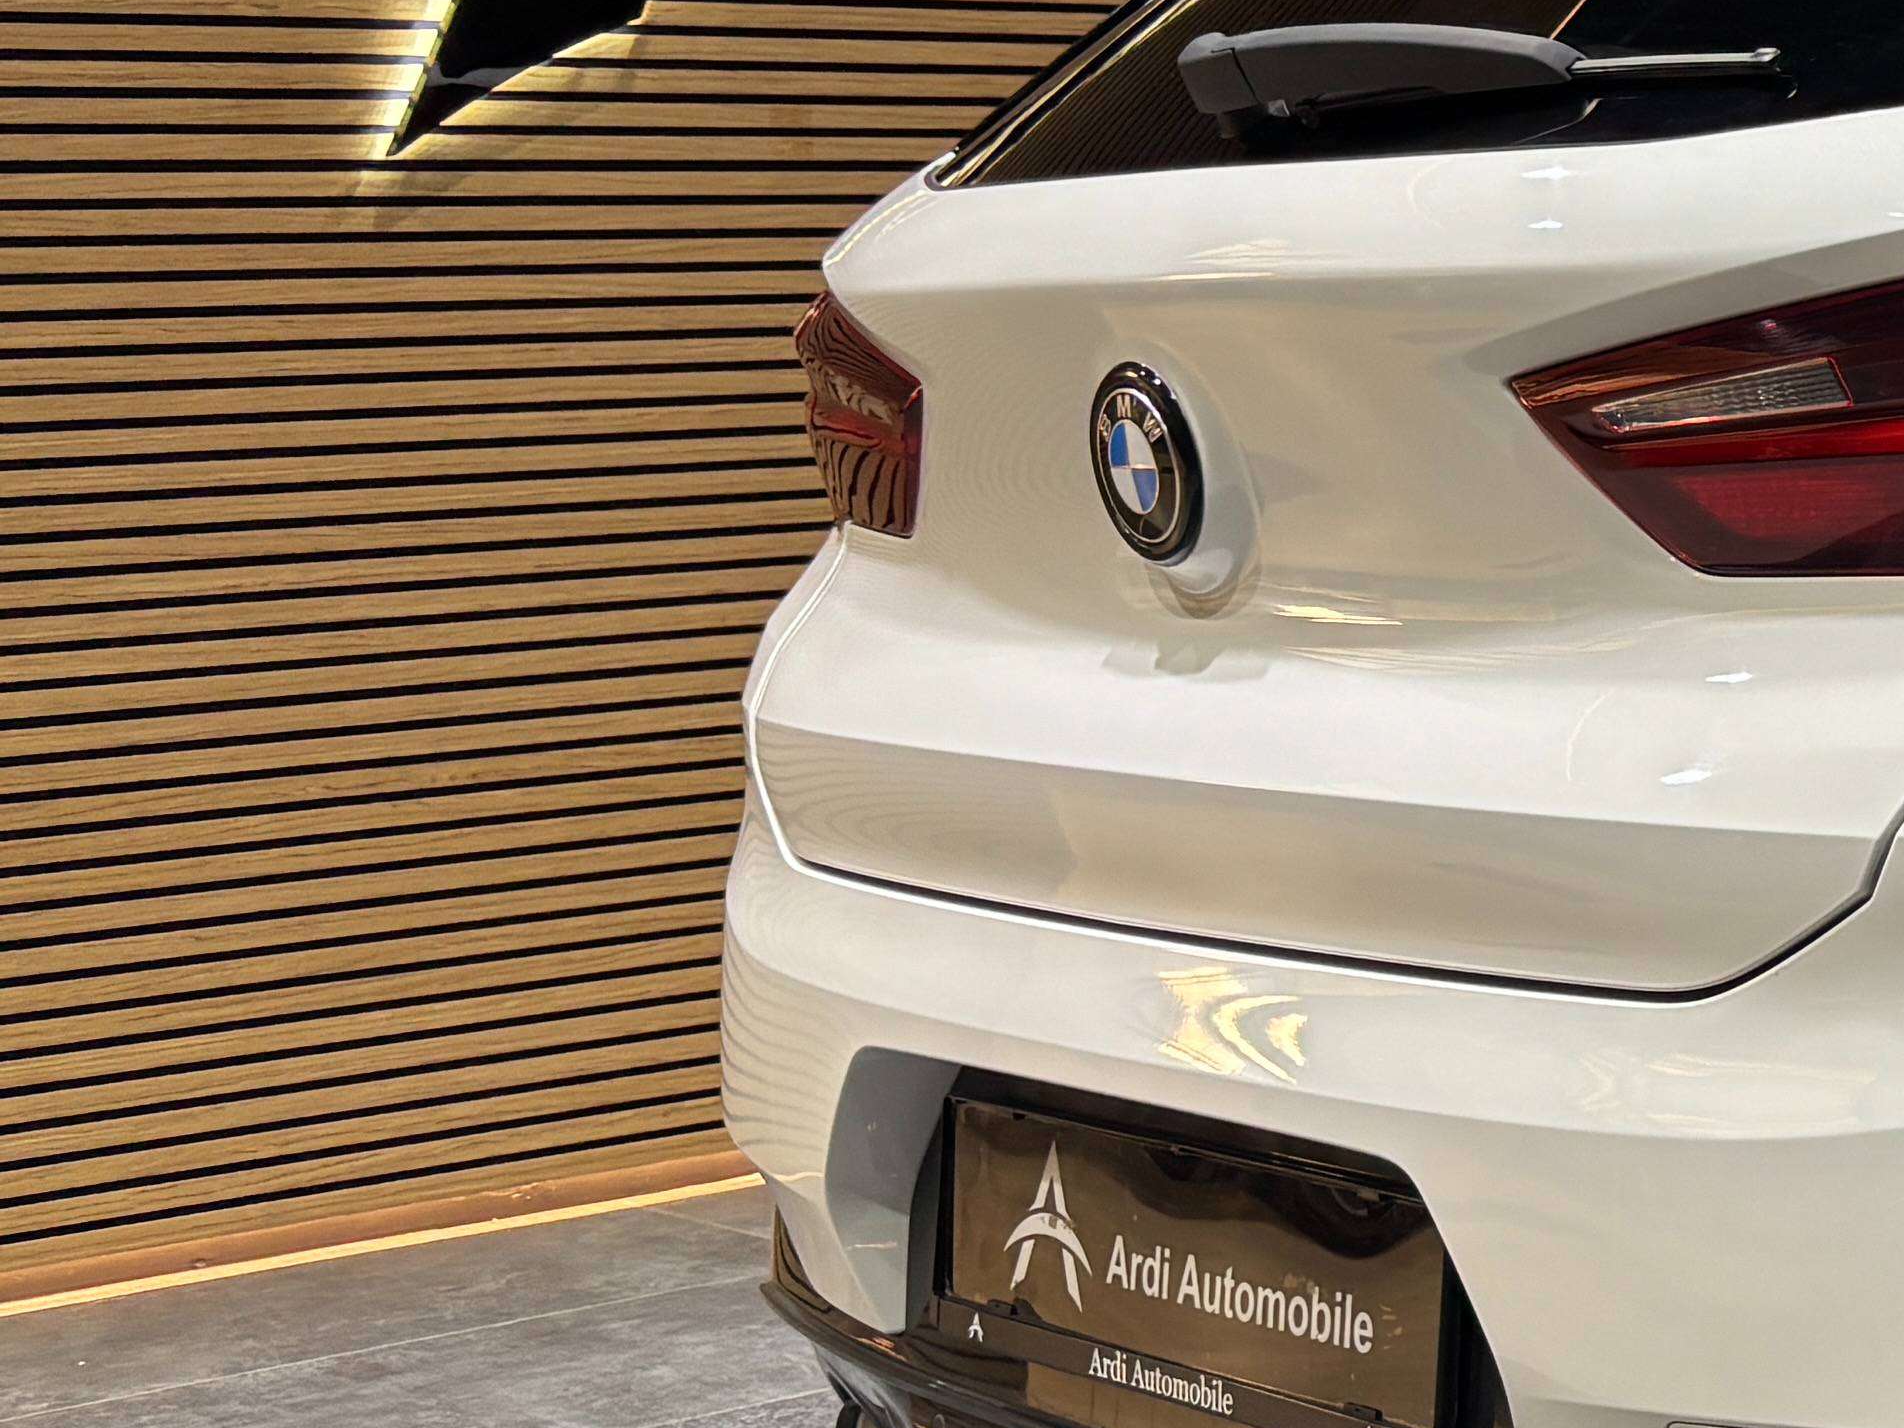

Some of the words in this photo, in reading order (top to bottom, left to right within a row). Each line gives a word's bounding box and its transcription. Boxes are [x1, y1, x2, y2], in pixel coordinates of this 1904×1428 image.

[1099, 392, 1164, 443] BMW
[1106, 1233, 1171, 1301] Ardi
[1176, 1252, 1375, 1355] Automobile
[1088, 1346, 1129, 1384] Ardi
[1130, 1356, 1235, 1417] Automobile
